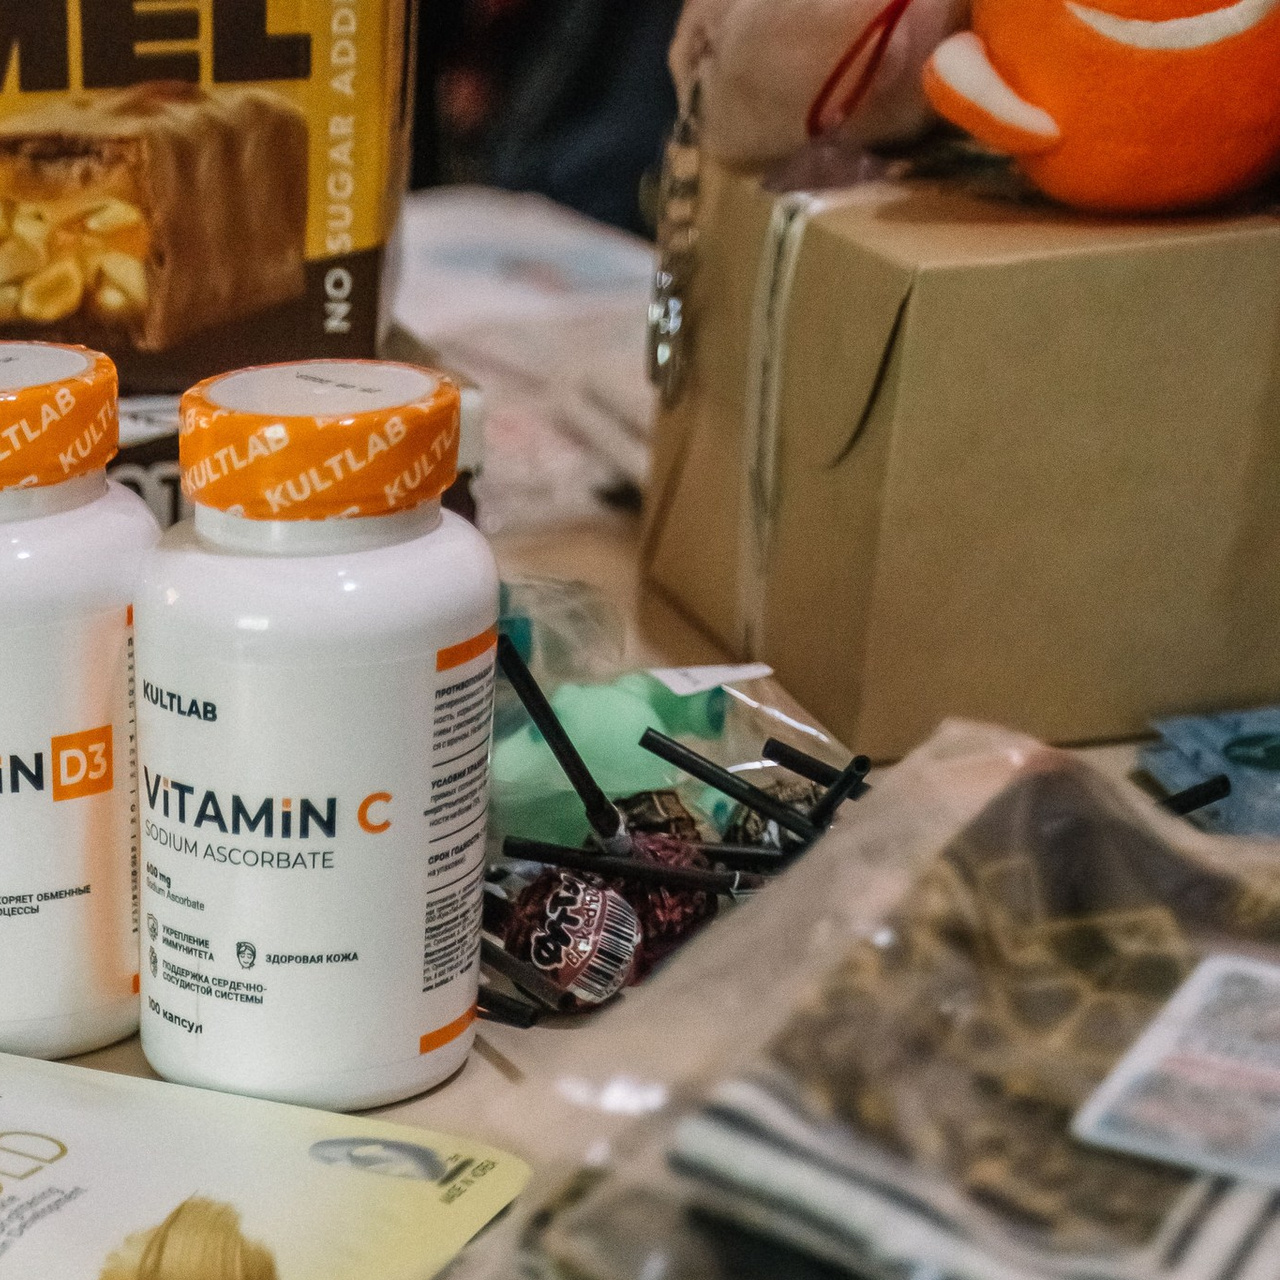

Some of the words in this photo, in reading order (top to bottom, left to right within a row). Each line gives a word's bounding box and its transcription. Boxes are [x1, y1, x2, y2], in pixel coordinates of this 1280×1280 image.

[329, 0, 358, 98] ADD
[326, 114, 355, 253] SUGAR
[323, 267, 353, 334] NO
[262, 416, 407, 514] KULTLAB
[142, 678, 218, 723] KULTLAB
[58, 741, 109, 787] D3
[356, 790, 394, 835] C
[145, 818, 199, 858] SODIUM
[202, 842, 335, 870] ASCORBATE
[146, 860, 160, 879] 600
[159, 871, 172, 889] mg
[166, 888, 206, 912] Ascorbate
[161, 958, 211, 985] ПОДДЕРЖКА
[265, 954, 325, 966] ЗДОРОВАЯ
[325, 951, 360, 964] КОЖА
[214, 989, 265, 1006] СИСТЕМЫ
[162, 1006, 204, 1035] капсул
